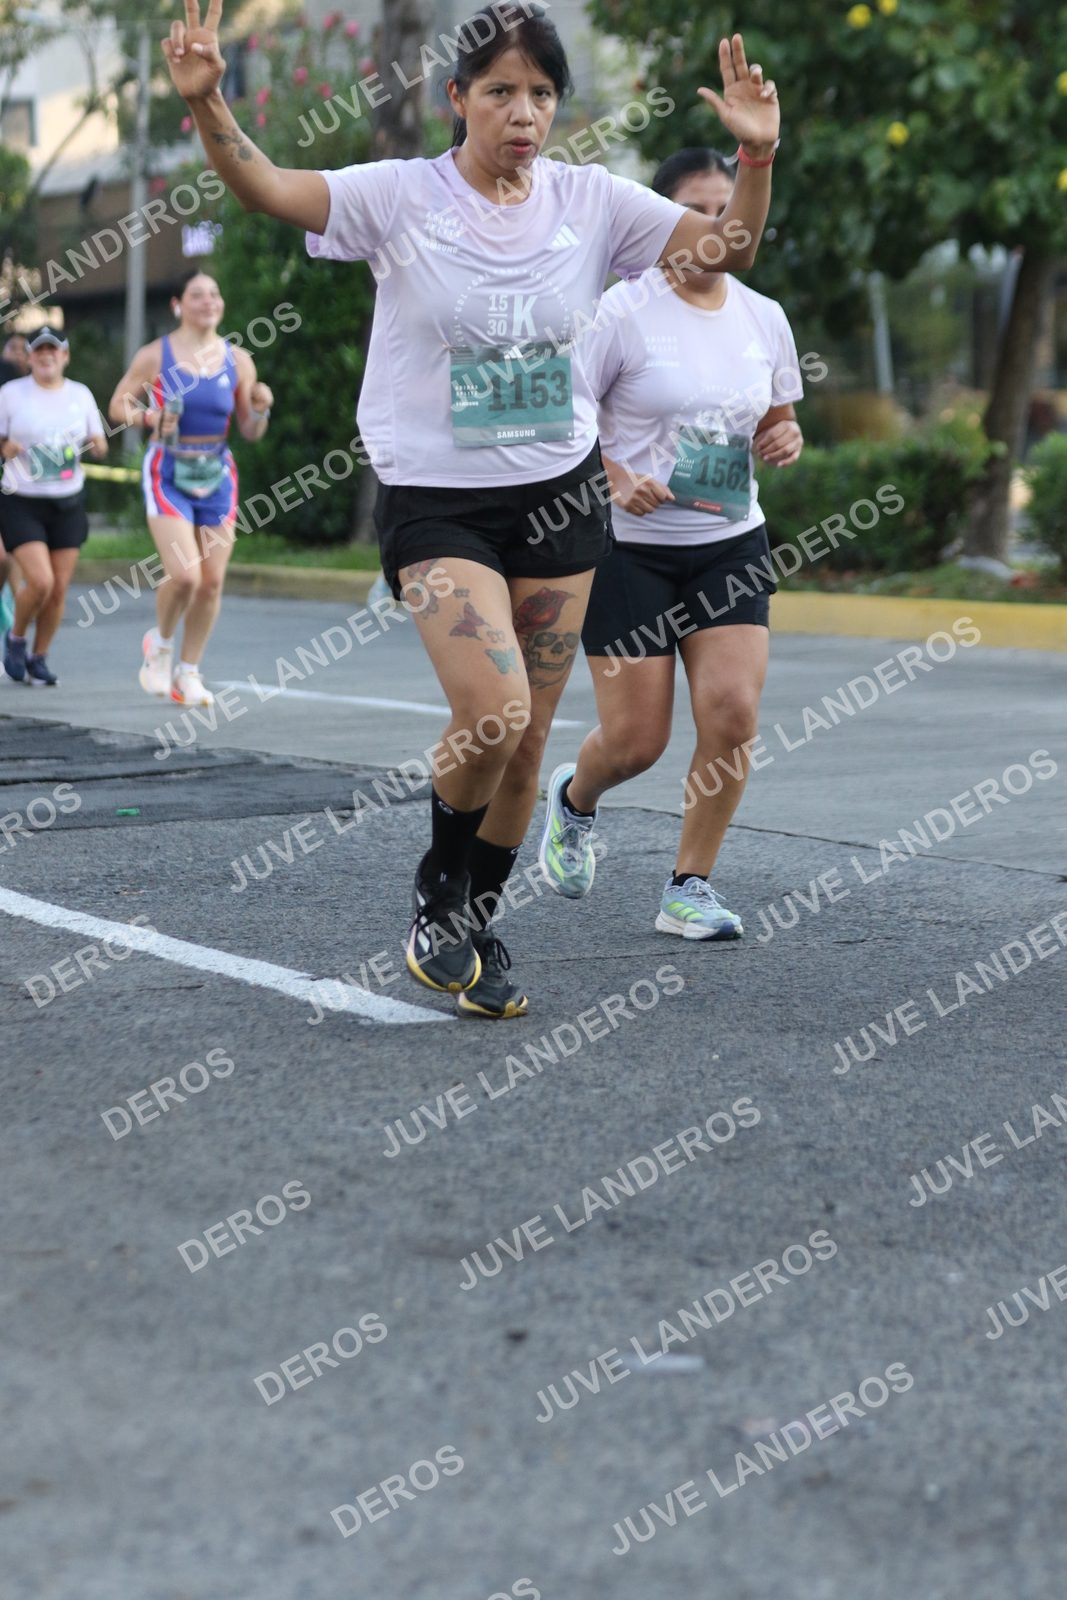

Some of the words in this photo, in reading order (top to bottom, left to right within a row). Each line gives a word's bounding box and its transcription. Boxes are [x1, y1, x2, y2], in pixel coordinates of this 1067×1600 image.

[488, 294, 508, 312] 15
[512, 295, 537, 336] K
[487, 319, 507, 337] 30
[488, 369, 568, 412] 1153
[497, 428, 536, 439] SAMSUNG
